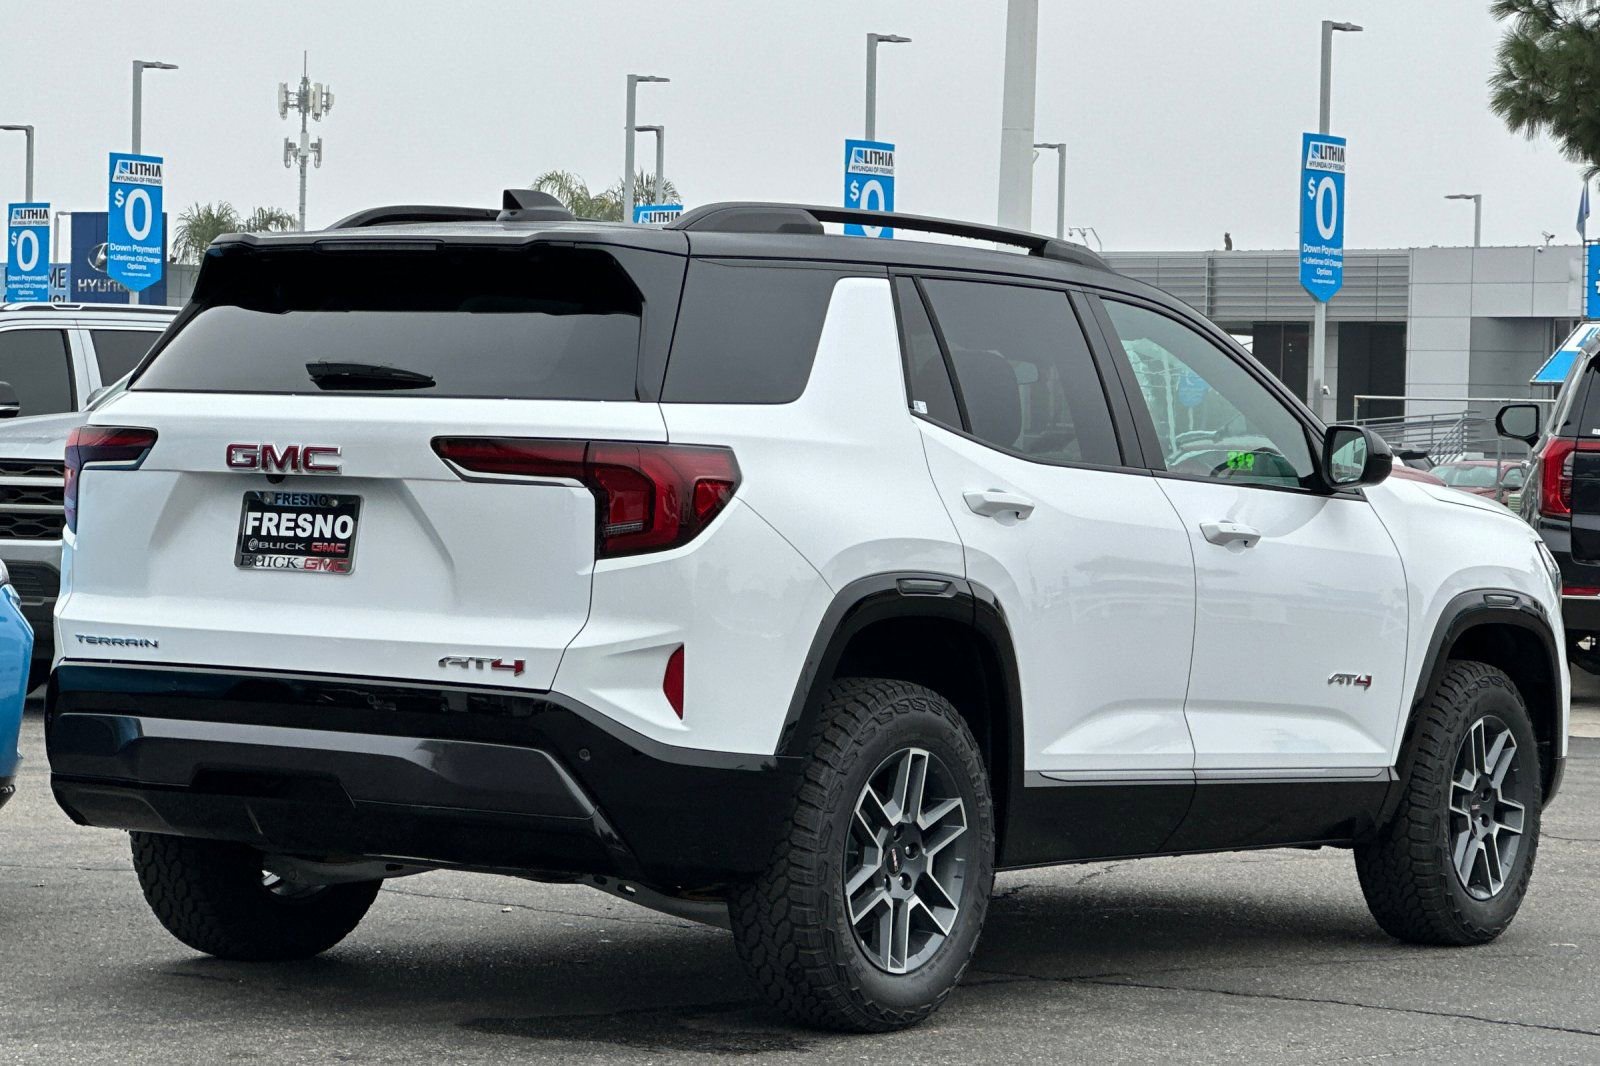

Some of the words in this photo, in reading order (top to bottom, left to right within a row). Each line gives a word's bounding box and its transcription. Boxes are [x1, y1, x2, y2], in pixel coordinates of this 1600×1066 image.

[864, 150, 894, 166] LITHIA
[1320, 144, 1344, 162] LITHIA
[130, 162, 162, 177] LITHIA
[20, 209, 48, 219] LITHIA
[110, 242, 131, 251] Down
[1303, 243, 1321, 254] Down
[226, 443, 342, 474] GMC
[274, 492, 328, 506] FRESNO
[246, 512, 354, 540] FRESNO
[258, 541, 306, 550] BUICK
[311, 542, 346, 553] GMC
[240, 554, 298, 568] BUICK
[304, 558, 349, 573] GMC
[75, 634, 160, 648] TERRAIN
[438, 655, 526, 677] AT4
[1328, 673, 1372, 691] AT4
